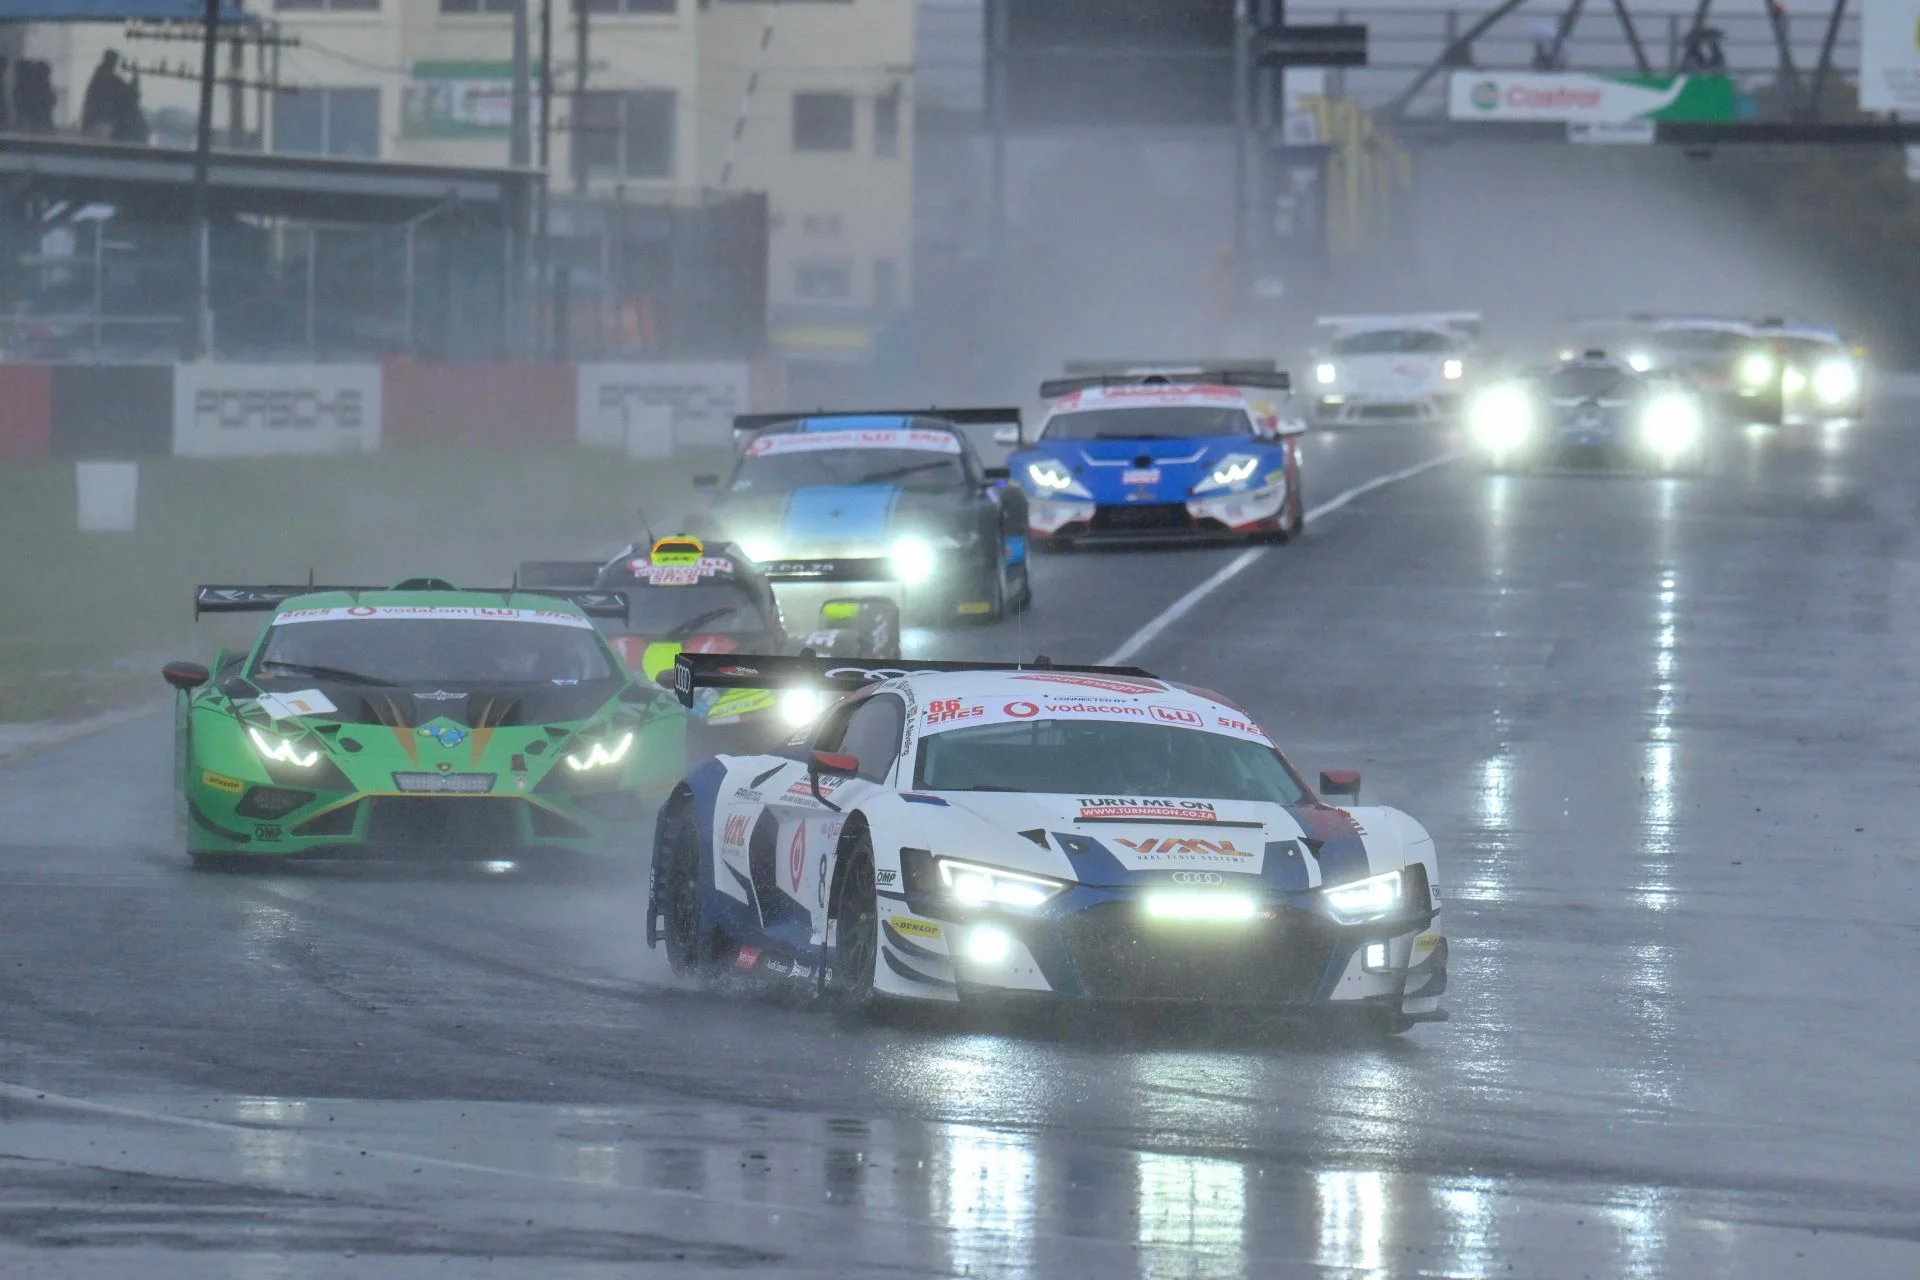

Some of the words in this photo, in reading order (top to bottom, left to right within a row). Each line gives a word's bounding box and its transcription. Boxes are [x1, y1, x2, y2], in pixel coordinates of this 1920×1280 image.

[195, 388, 362, 428] PORSCHE
[929, 698, 961, 714] 86
[1045, 703, 1145, 716] vodacom
[1157, 708, 1196, 723] 4U
[1079, 798, 1137, 807] TURN
[1142, 799, 1175, 808] ME
[1179, 801, 1215, 811] ON
[1083, 807, 1215, 820] WWW.TURNMEON.CO.ZA
[255, 827, 283, 839] OMP
[877, 870, 897, 883] OMP
[899, 921, 939, 934] DUNLOP
